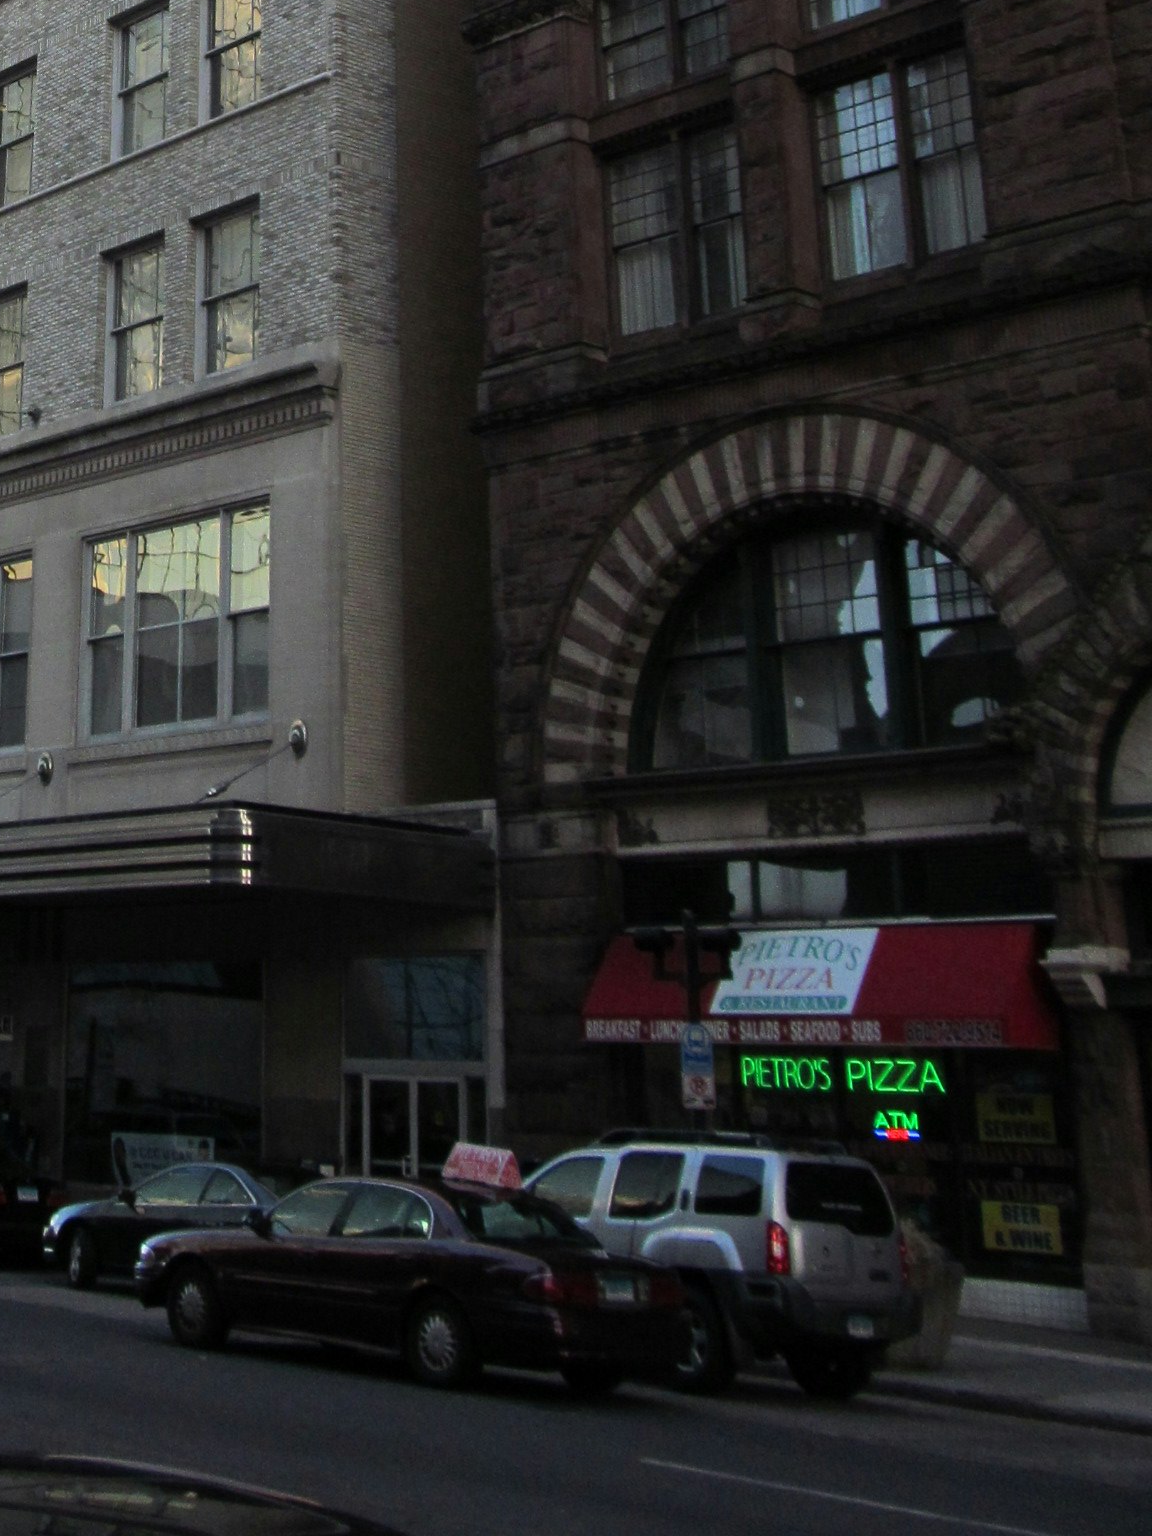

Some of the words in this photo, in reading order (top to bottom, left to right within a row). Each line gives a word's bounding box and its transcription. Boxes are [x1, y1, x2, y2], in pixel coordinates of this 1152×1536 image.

[738, 936, 862, 971] PIETRO'S
[744, 967, 834, 990] PIZZA
[585, 1019, 642, 1041] BREAKFAST
[739, 1020, 781, 1042] SALADS
[790, 1020, 841, 1042] SEAFOOD
[851, 1020, 881, 1042] SUBS
[740, 1056, 832, 1091] PIETRO'S
[846, 1059, 947, 1093] PIZZA
[874, 1111, 920, 1130] ATM
[1001, 1204, 1041, 1225] BEER
[1008, 1230, 1054, 1251] WINE
